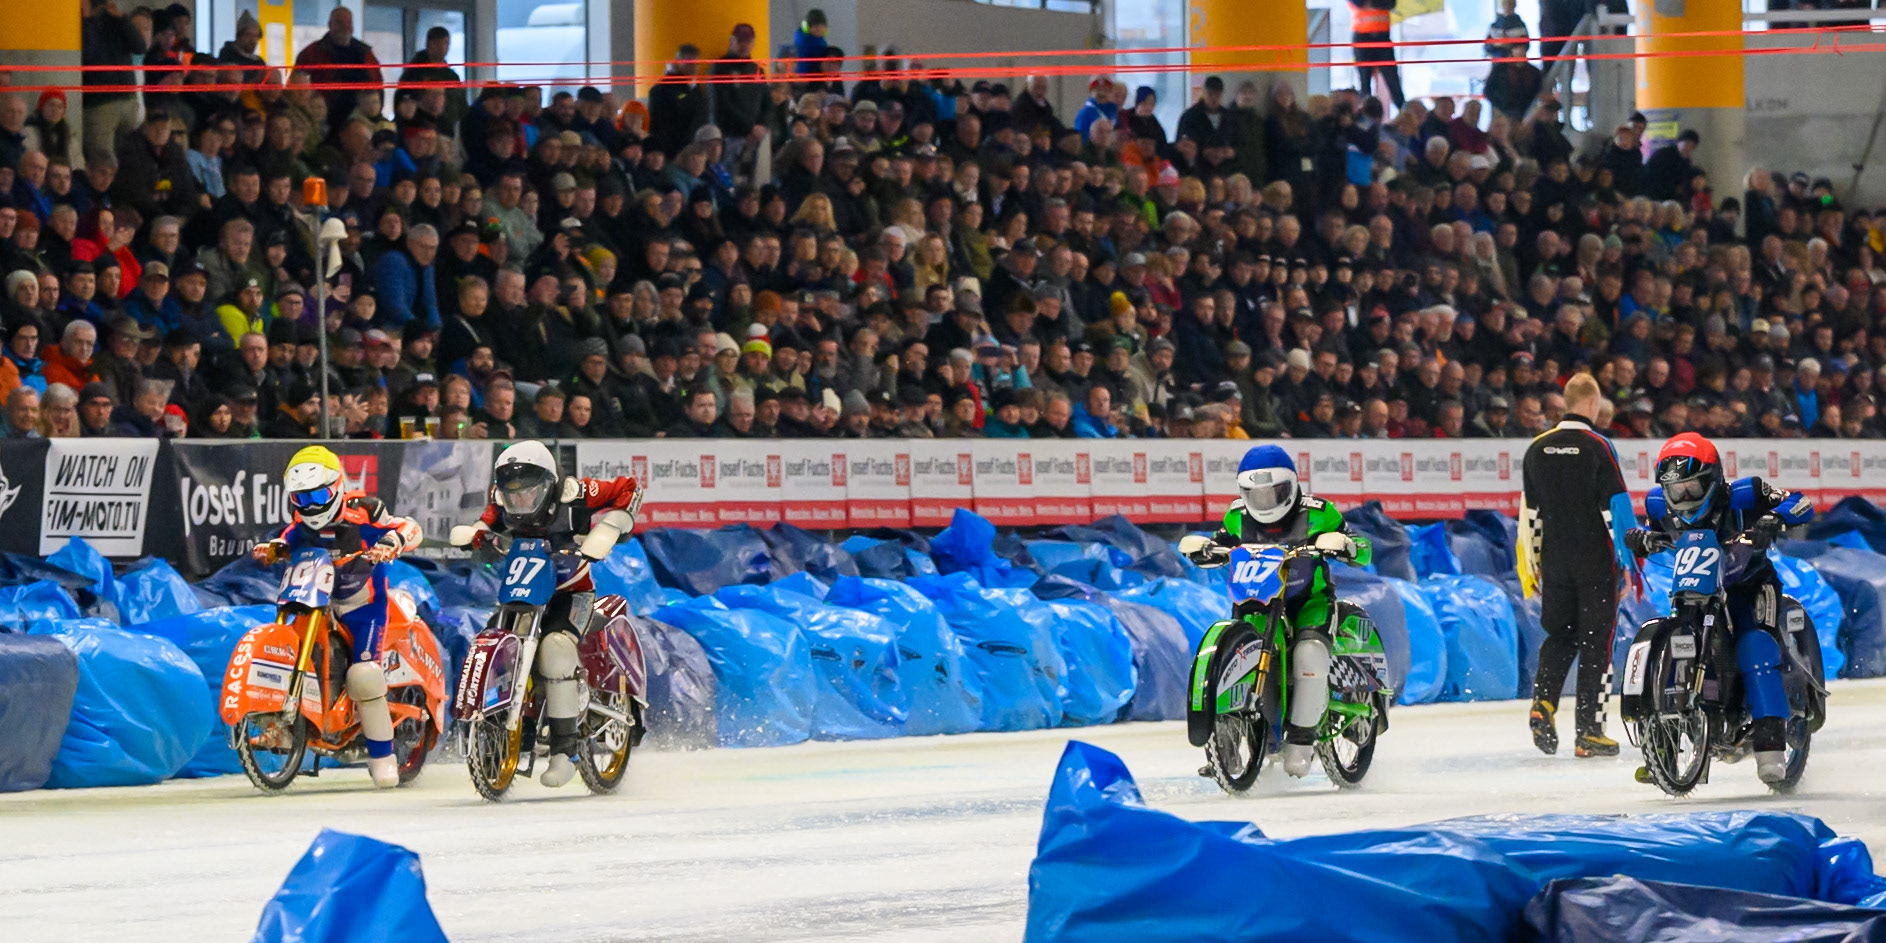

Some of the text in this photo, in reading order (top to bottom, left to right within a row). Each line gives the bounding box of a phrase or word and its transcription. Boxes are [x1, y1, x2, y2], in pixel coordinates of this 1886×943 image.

[55, 455, 149, 488] WATCH ON
[47, 500, 141, 532] FIM-MOTO.TV
[181, 469, 246, 538] Josef
[505, 556, 546, 586] 97
[1232, 560, 1280, 584] 107
[1672, 546, 1720, 579] 192
[510, 587, 531, 597] FIM
[1678, 577, 1700, 587] FIM
